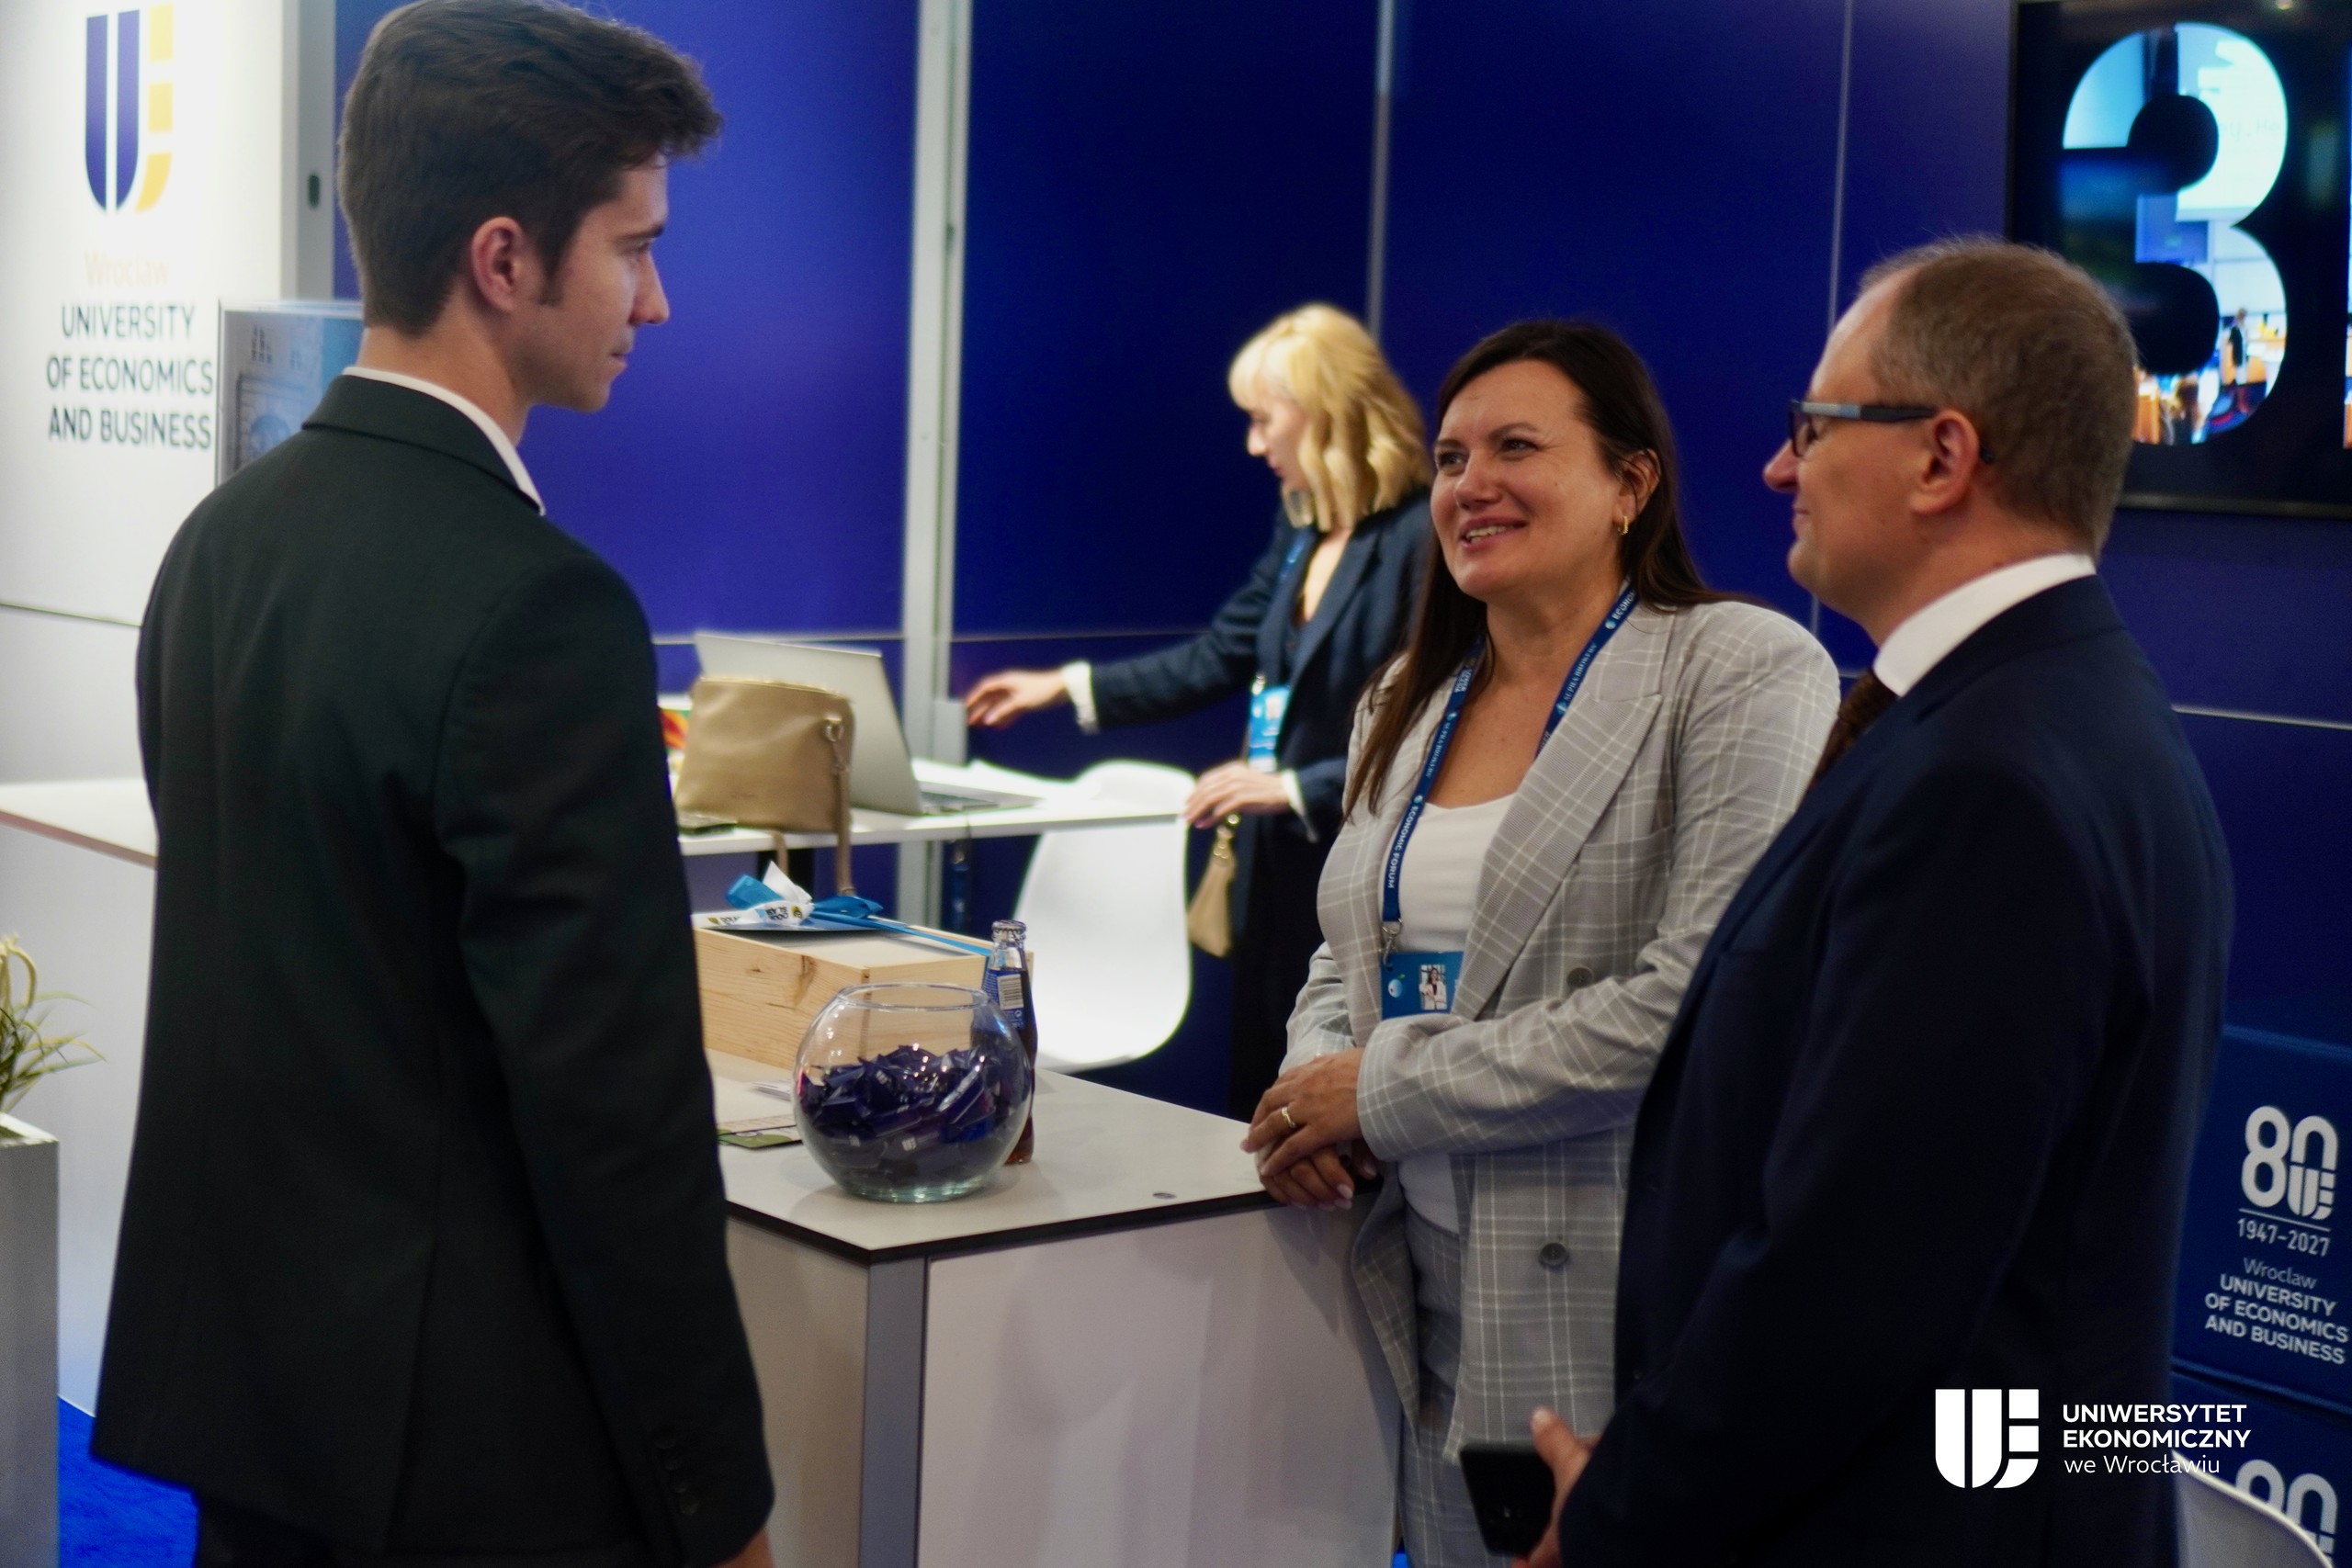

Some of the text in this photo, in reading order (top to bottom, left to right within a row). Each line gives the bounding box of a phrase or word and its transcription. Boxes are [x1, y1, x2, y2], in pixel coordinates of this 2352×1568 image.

[61, 303, 196, 340] UNIVERSITY
[46, 355, 214, 396] OF ECONOMICS
[48, 404, 212, 451] AND BUSINESS
[1386, 805, 1419, 889] ECONOMIC FORUM
[2220, 1273, 2337, 1317] UNIVERSITY
[2243, 1257, 2318, 1291] Wroclaw
[2205, 1292, 2349, 1344] OF ECONOMICS
[2205, 1314, 2346, 1365] AND BUSINESS
